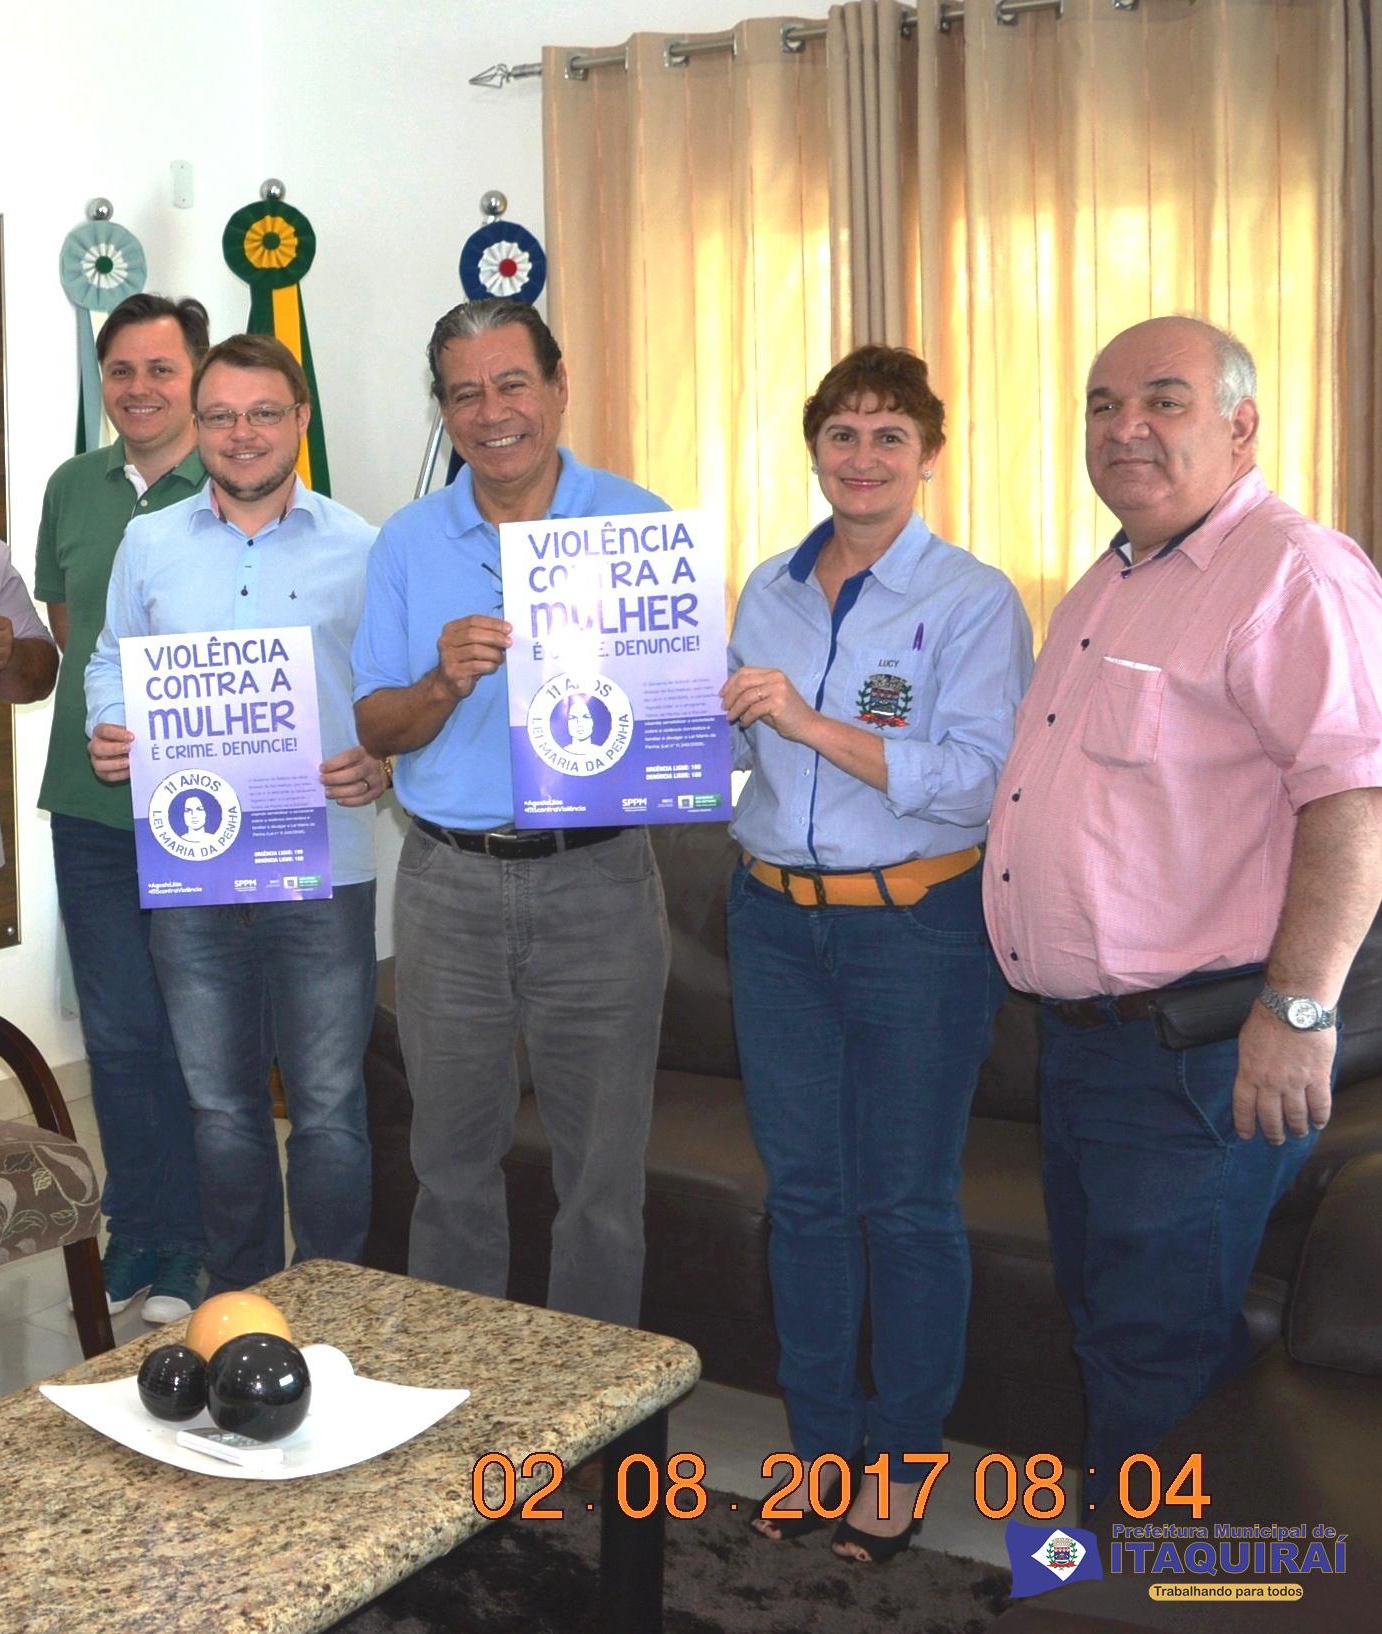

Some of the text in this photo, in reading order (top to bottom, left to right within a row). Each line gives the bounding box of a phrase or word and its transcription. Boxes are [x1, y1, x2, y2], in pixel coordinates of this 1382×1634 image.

[528, 521, 694, 560] VIOLÊNCIA
[529, 557, 696, 593] CORA A
[144, 636, 289, 671] VIOLÊNCIA
[533, 642, 543, 660] É
[615, 635, 700, 657] DENUNCIE!
[878, 659, 899, 668] LUCY
[146, 668, 292, 700] CONTRA A
[148, 700, 296, 740] MULHER
[151, 738, 298, 760] É CRIME. DENUNCIE!
[531, 717, 544, 740] LEI
[540, 741, 579, 772] MARIA
[586, 757, 605, 772] DA
[607, 713, 629, 760] PENHA
[180, 774, 222, 792] ANOS
[622, 797, 647, 807] SPPM
[152, 810, 164, 830] LEI
[161, 831, 195, 858] MARIA
[201, 844, 218, 857] DA
[220, 805, 238, 847] PENHA
[234, 879, 257, 888] SPPM
